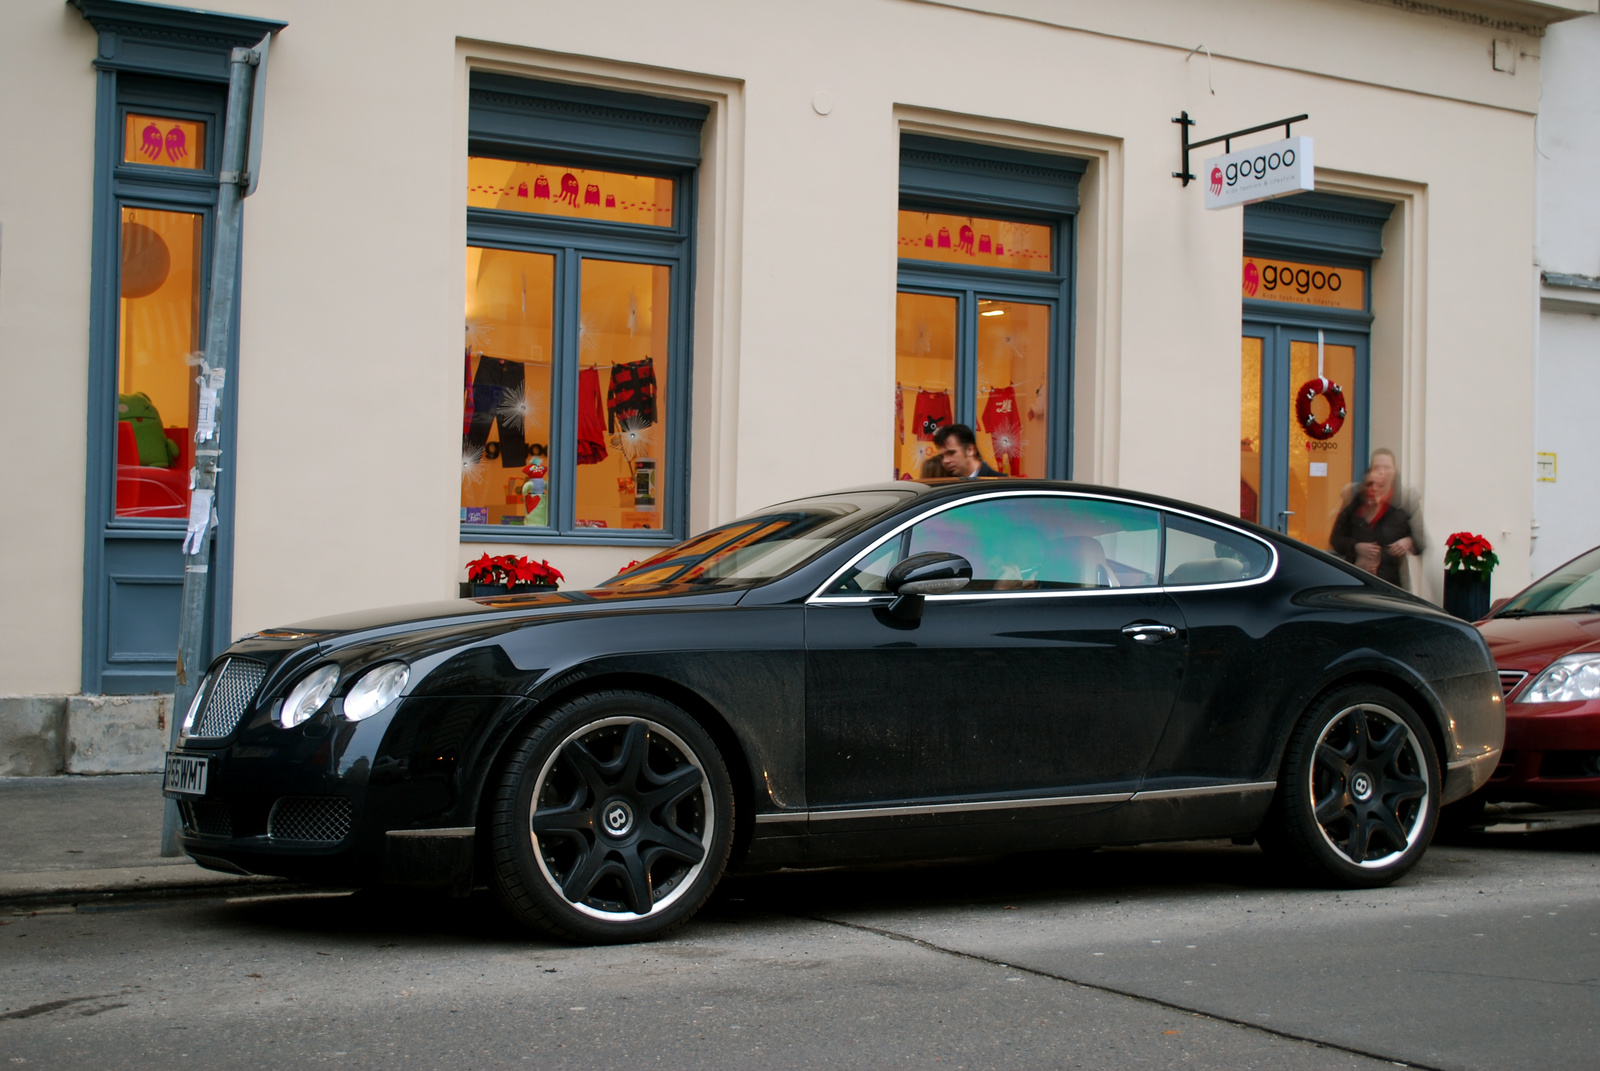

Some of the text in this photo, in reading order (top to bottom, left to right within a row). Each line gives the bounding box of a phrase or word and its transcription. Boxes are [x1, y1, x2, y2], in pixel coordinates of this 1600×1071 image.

[1226, 149, 1295, 186] gogoo
[1239, 182, 1262, 191] fashion
[1270, 175, 1295, 184] lifestyle
[1263, 265, 1342, 294] gogoo
[1279, 294, 1304, 302] fashion
[1314, 298, 1340, 306] lifestyle
[1311, 441, 1338, 451] gogoo
